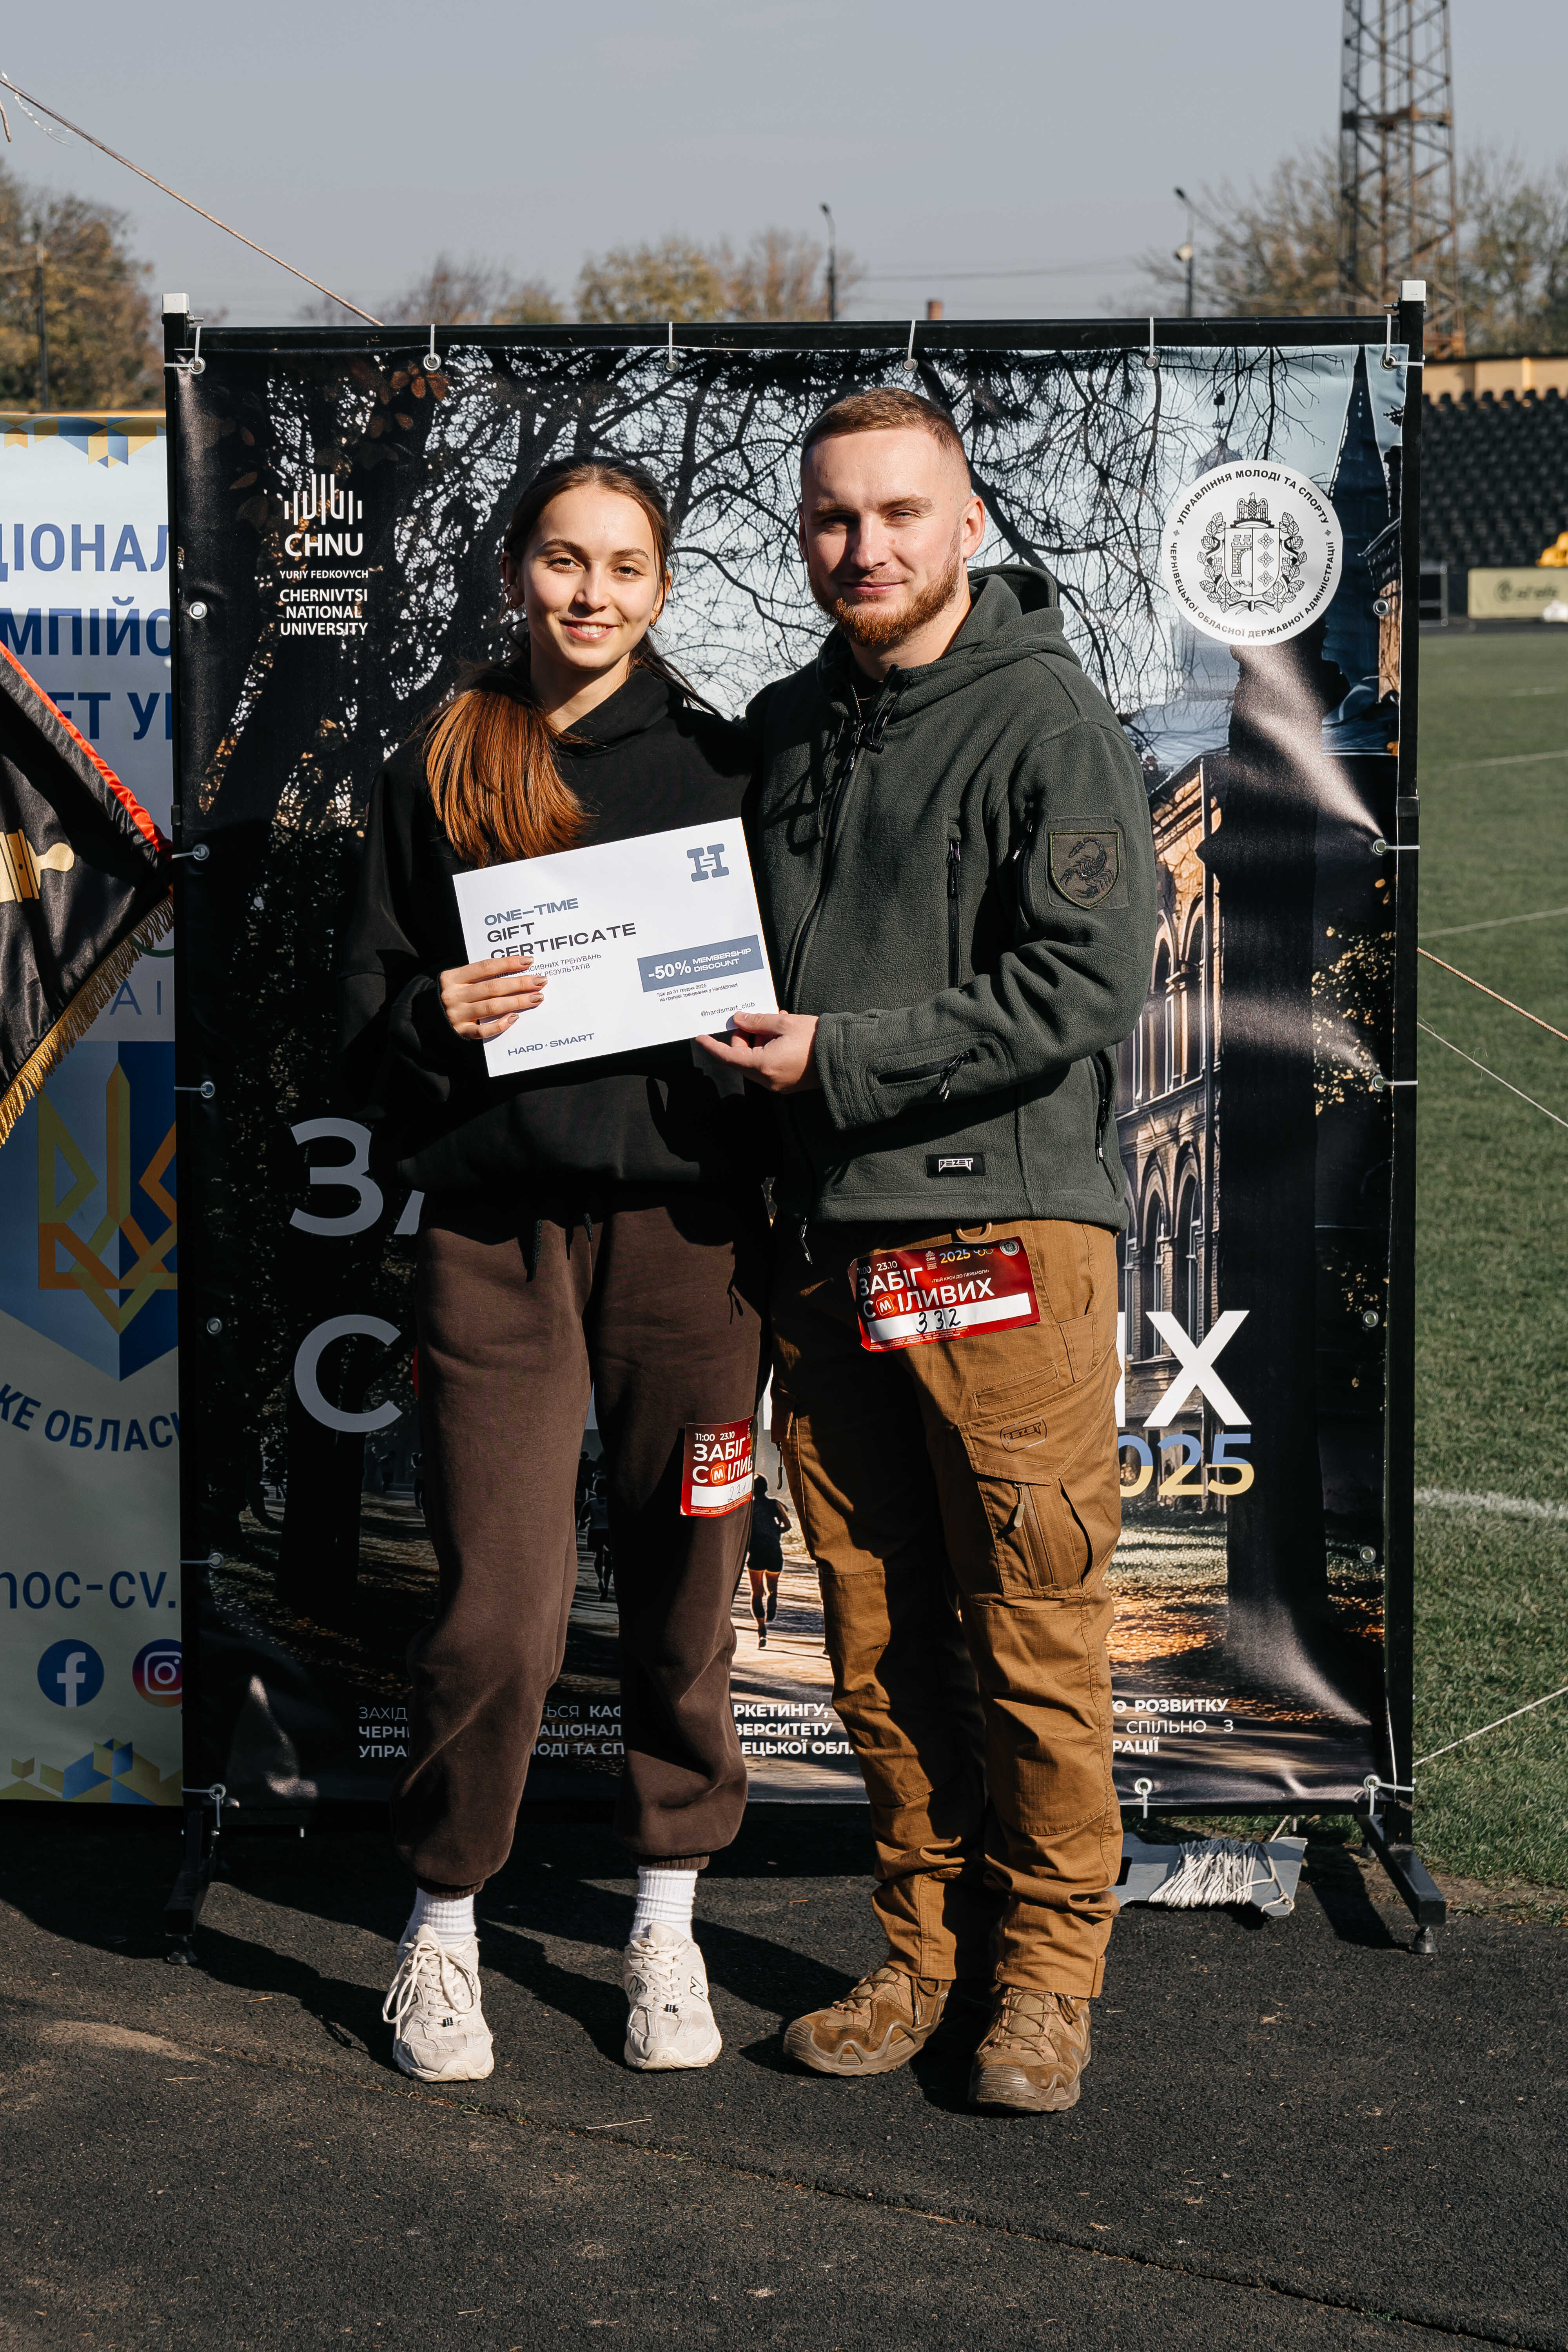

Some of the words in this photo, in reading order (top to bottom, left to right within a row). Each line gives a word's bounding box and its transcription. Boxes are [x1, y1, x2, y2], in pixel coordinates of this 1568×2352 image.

[1177, 473, 1232, 525] УПРАВЛІННЯ
[1235, 470, 1281, 481] МОЛОДІ
[1284, 477, 1296, 489] ТА
[1298, 487, 1329, 524] СПОРТУ
[285, 533, 363, 556] CHNU
[279, 570, 308, 579] YURIY
[311, 570, 368, 579] FEDKOVYCH
[280, 589, 368, 602] CHERNIVTSI
[1170, 543, 1198, 613] ЧЕРНІВЕЦЬКОЇ
[1198, 612, 1246, 637] ОБЛАСНОЇ
[1248, 613, 1304, 638] ДЕРЖАВНОЇ
[1306, 542, 1335, 614] АДМІНІСТРАЦІЇ
[286, 606, 363, 618] NATIONAL
[281, 622, 368, 635] UNIVERSITY
[127, 692, 172, 740] У
[487, 922, 535, 942] GIFT
[490, 922, 636, 959] CERTIFICATE
[560, 953, 601, 965] ТРЕНУВАНЬ
[692, 948, 752, 965] MEMBERSHIP
[694, 958, 739, 972] DISCOUNT
[544, 963, 590, 976] РЕЗУЛЬТАТІВ
[648, 960, 691, 979] -50%
[712, 983, 738, 992] Hard&Smart
[701, 1002, 755, 1017] @hardsmart_club
[508, 1043, 543, 1056] HARD
[550, 1033, 595, 1047] SMART
[289, 1118, 425, 1236] З
[939, 1249, 971, 1263] 2025
[877, 1261, 897, 1271] 23.10
[859, 1267, 923, 1296] ЗАБІГ
[916, 1308, 961, 1333] 332
[1114, 1310, 1252, 1427] Х
[695, 1433, 715, 1441] 11:00
[720, 1431, 735, 1441] 23.10
[693, 1437, 746, 1462] ЗАБІГ
[359, 1707, 408, 1722] ЗАХІД
[543, 1705, 579, 1718] ЬСЯ
[733, 1703, 829, 1719] РКЕТИНГУ,
[1135, 1698, 1229, 1713] РОЗВИТКУ
[1126, 1719, 1207, 1734] СПІЛЬНО
[1223, 1719, 1234, 1733] З
[359, 1745, 410, 1758] УПРА
[573, 1743, 596, 1755] ТА
[741, 1739, 808, 1757] ЕЦЬКОЇ
[811, 1742, 855, 1755] ОБЛ
